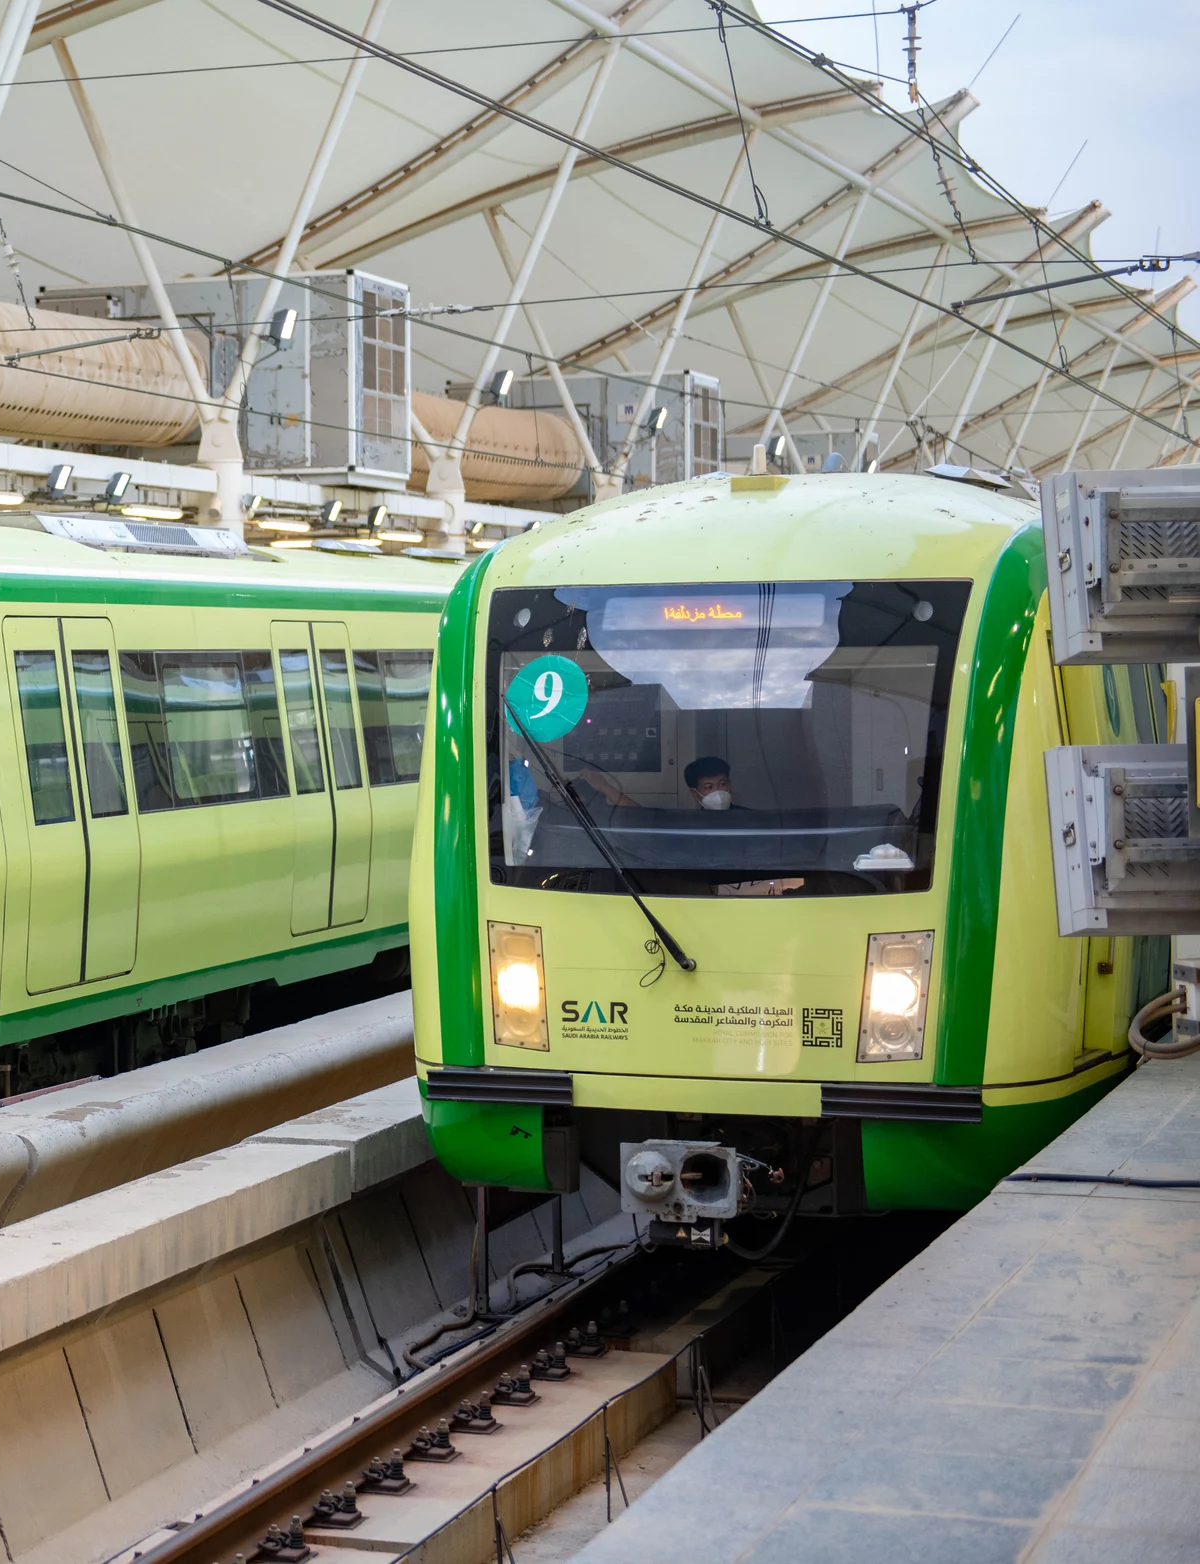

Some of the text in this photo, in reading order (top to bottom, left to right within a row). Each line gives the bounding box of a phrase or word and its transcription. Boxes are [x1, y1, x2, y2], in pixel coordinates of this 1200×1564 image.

[708, 604, 742, 619] محطة
[529, 671, 563, 720] 9
[561, 1000, 628, 1024] SAR
[674, 1004, 793, 1015] الهيئة الملكية لمدينة مكة
[674, 1015, 793, 1028] المكرمة والمشاعر المقدسة
